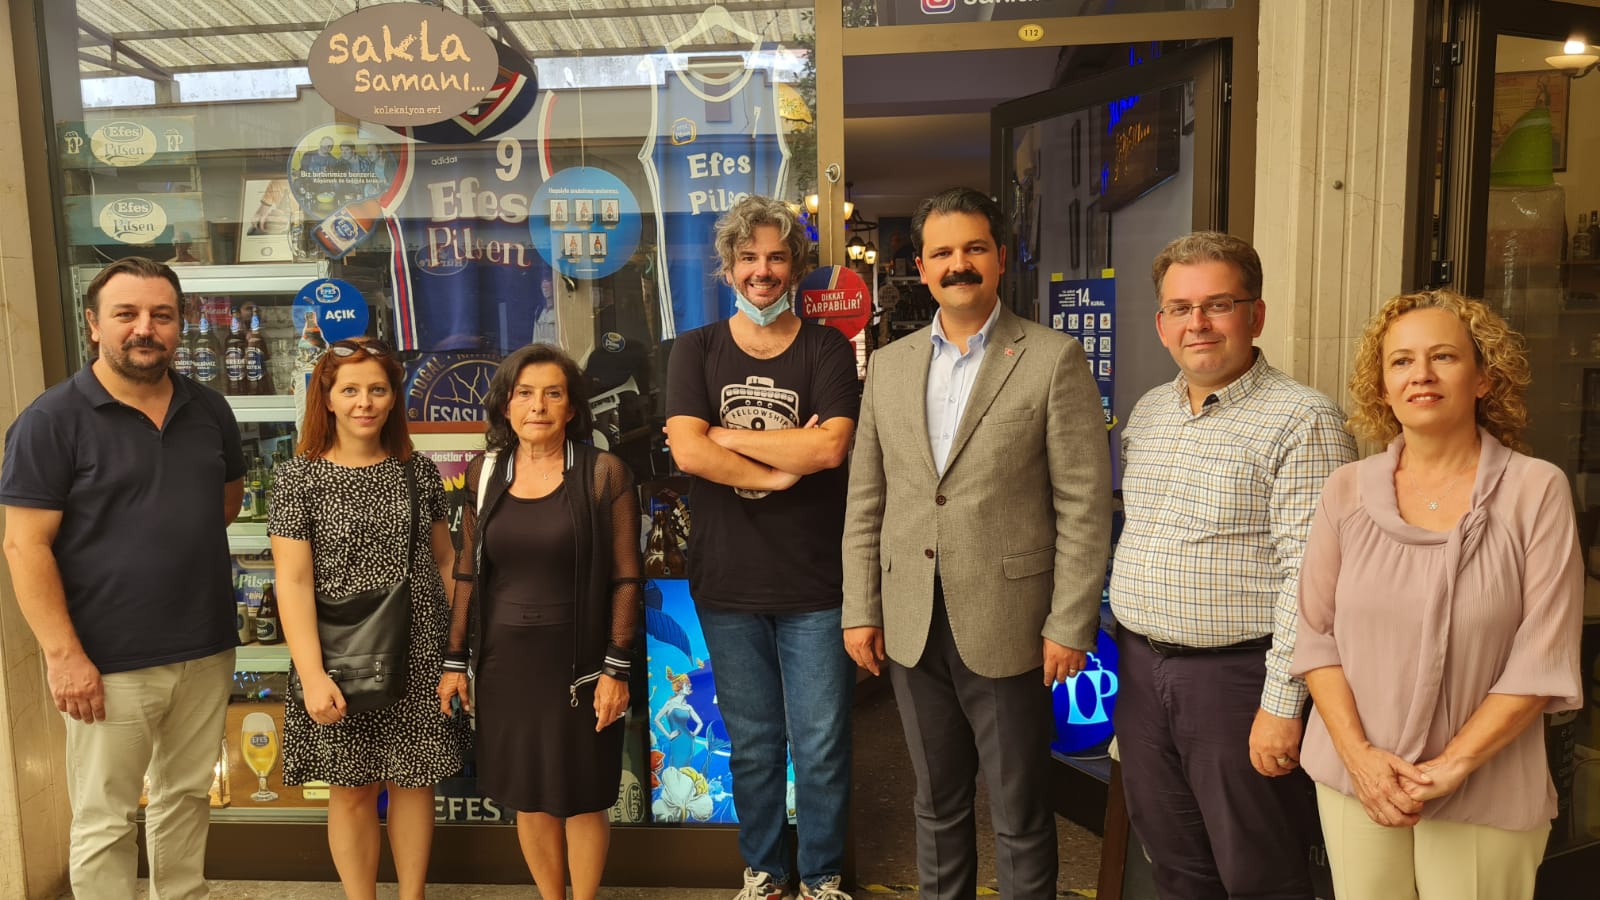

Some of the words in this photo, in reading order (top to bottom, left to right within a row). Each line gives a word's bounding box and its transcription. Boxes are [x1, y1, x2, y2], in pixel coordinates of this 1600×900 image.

[1023, 29, 1039, 37] 112
[328, 20, 471, 65] sakla
[374, 105, 425, 116] koleksiyon
[426, 105, 442, 114] evi
[108, 126, 140, 137] Efes
[104, 143, 145, 160] Pilsen
[495, 137, 523, 182] 9
[431, 155, 458, 166] adidas
[687, 152, 752, 179] Efes
[117, 202, 149, 213] Efes
[428, 177, 528, 224] Efes
[113, 219, 155, 237] Pilsen
[428, 226, 530, 269] Pilsen
[821, 292, 845, 301] DİKKAT
[1075, 287, 1090, 307] 14
[325, 309, 356, 322] AÇIK
[806, 299, 860, 315] ÇARPABİLİR!
[731, 408, 789, 426] FELLOWSHIP
[435, 798, 501, 822] EFES
